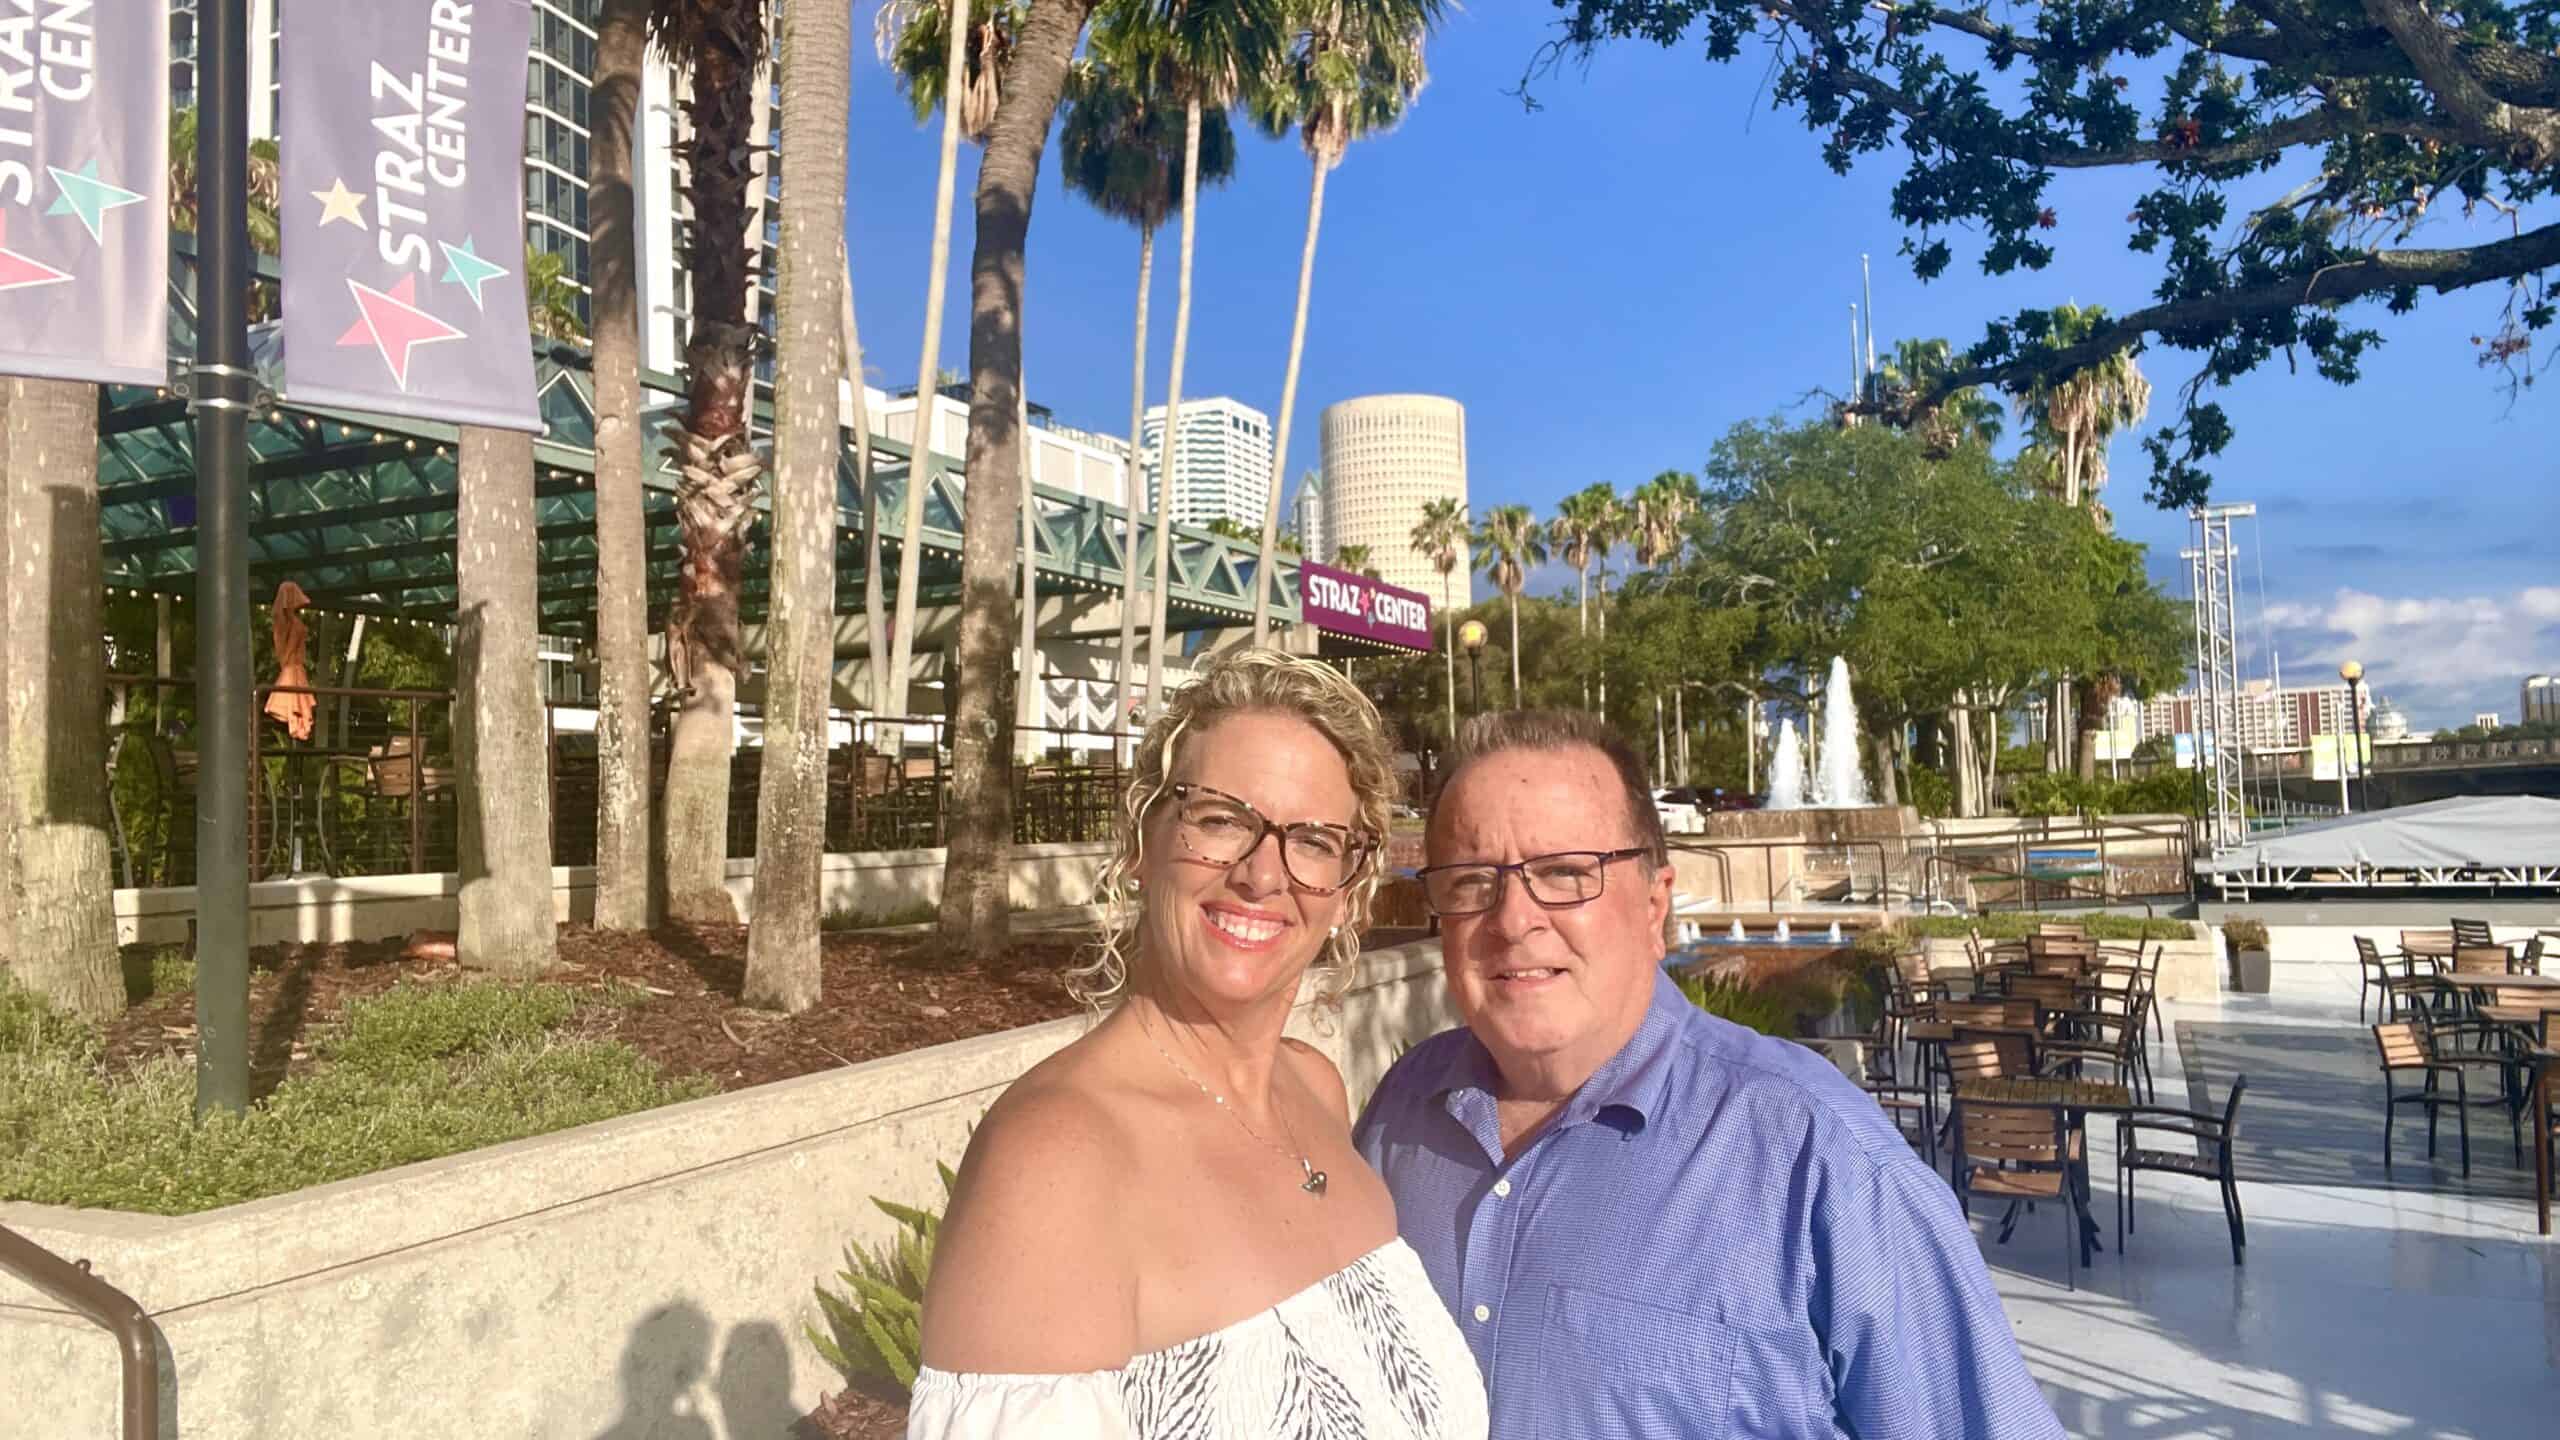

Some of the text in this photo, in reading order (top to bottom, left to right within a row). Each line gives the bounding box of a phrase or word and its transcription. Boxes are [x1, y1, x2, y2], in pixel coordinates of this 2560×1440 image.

[370, 59, 431, 273] STRAZ
[426, 0, 473, 189] CENTER
[1309, 574, 1427, 632] STRAZ CENTER
